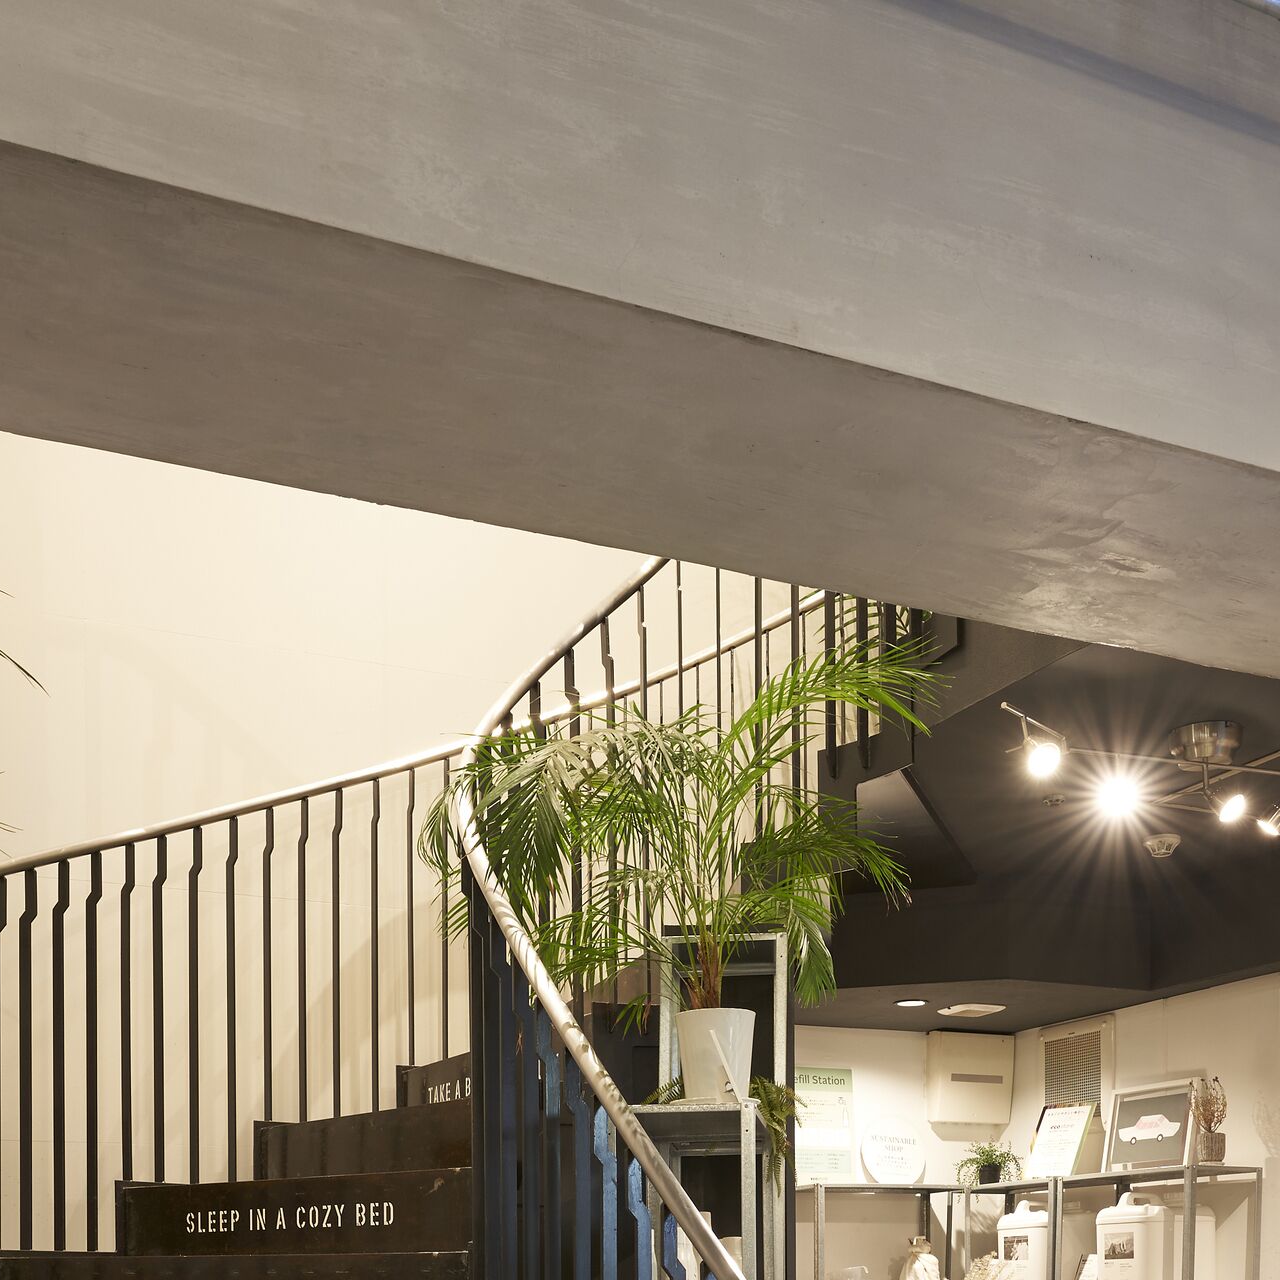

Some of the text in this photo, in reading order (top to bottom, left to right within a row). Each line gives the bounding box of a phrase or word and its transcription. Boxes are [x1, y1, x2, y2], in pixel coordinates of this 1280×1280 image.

[428, 1077, 471, 1104] TAKE A B
[793, 1074, 846, 1086] efill Station
[186, 1201, 394, 1234] SLEEP IN A COZY BED
